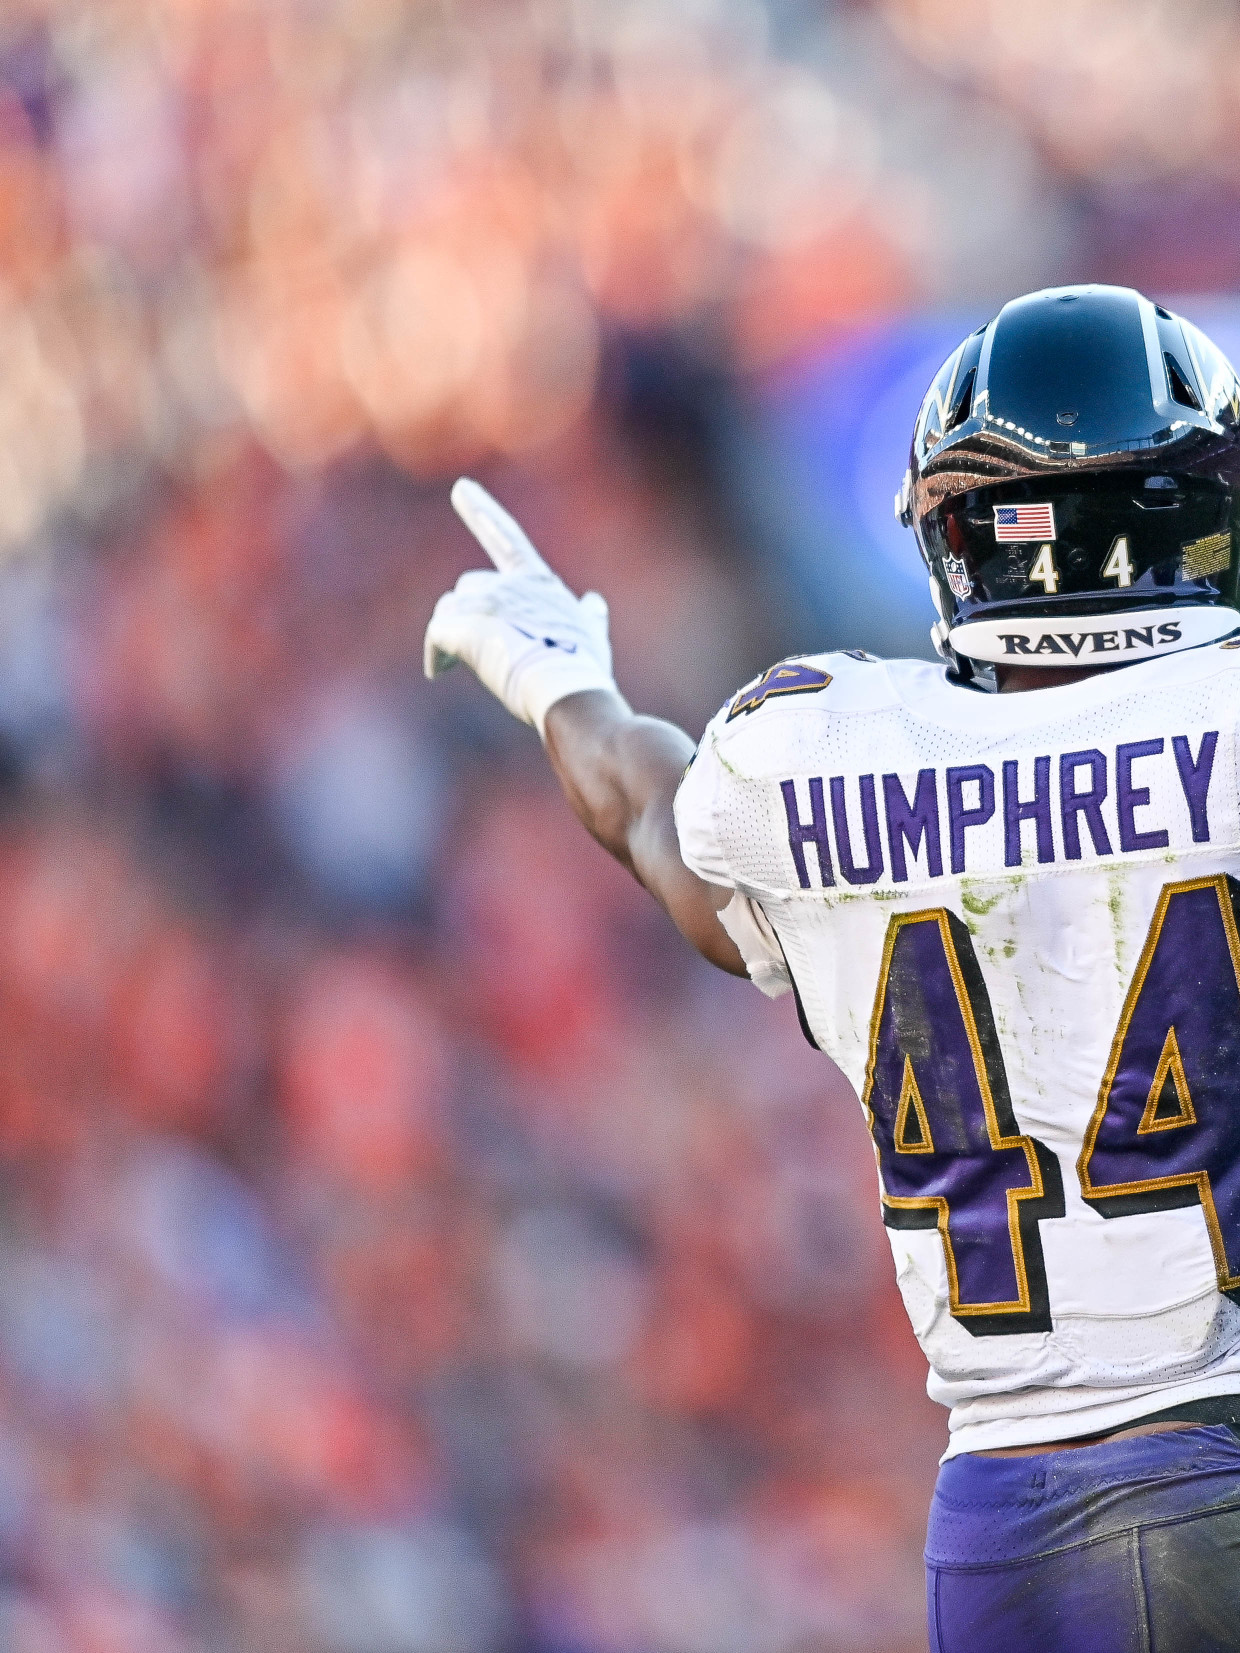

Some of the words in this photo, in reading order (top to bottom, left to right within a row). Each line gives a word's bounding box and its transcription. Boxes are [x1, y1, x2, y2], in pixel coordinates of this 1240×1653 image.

[1029, 543, 1060, 594] 4
[1102, 537, 1134, 588] 4
[996, 621, 1183, 659] RAVENS
[779, 730, 1220, 889] HUMPHREY
